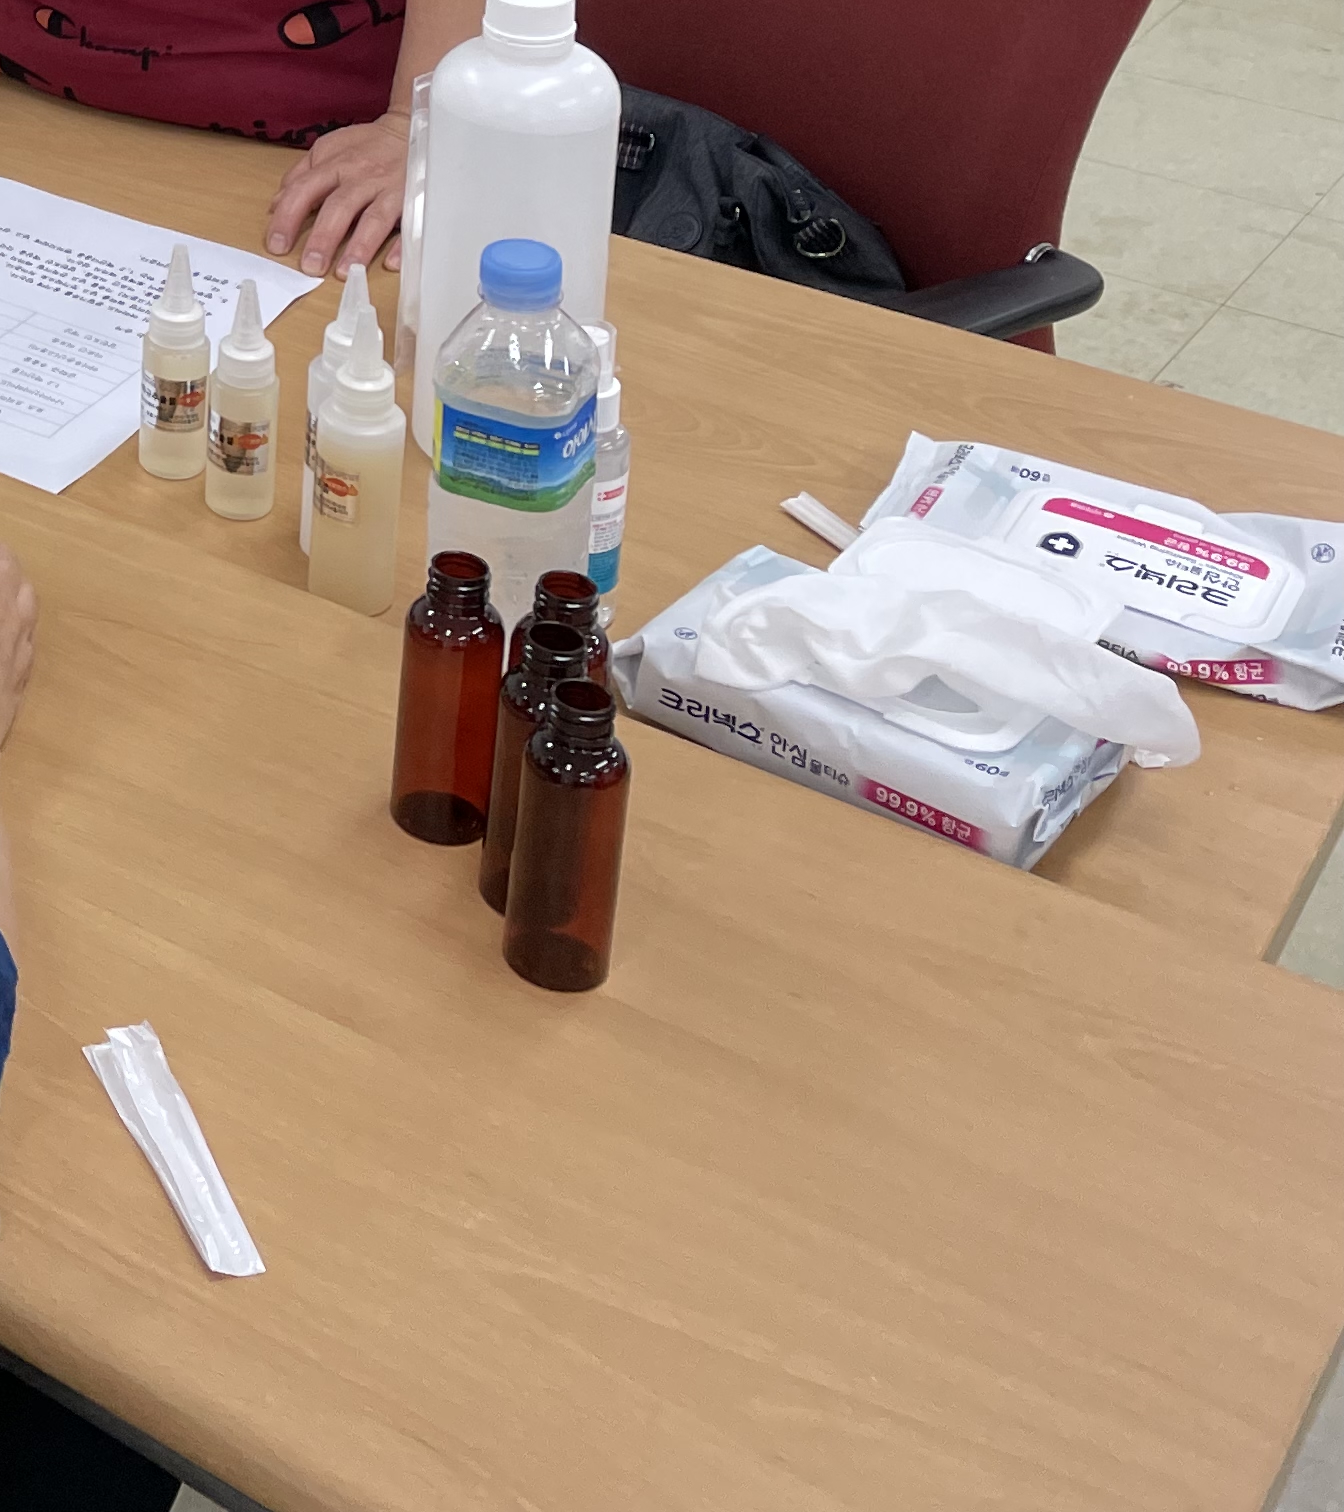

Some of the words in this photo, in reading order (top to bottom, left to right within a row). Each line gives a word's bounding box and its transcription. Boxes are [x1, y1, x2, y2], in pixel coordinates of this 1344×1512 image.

[1103, 553, 1237, 608] 크리넥스
[1203, 570, 1241, 592] 안심
[657, 687, 764, 744] 크리넥스
[768, 731, 809, 769] 안심
[874, 785, 936, 827] 99.9%
[941, 815, 972, 842] 항균
